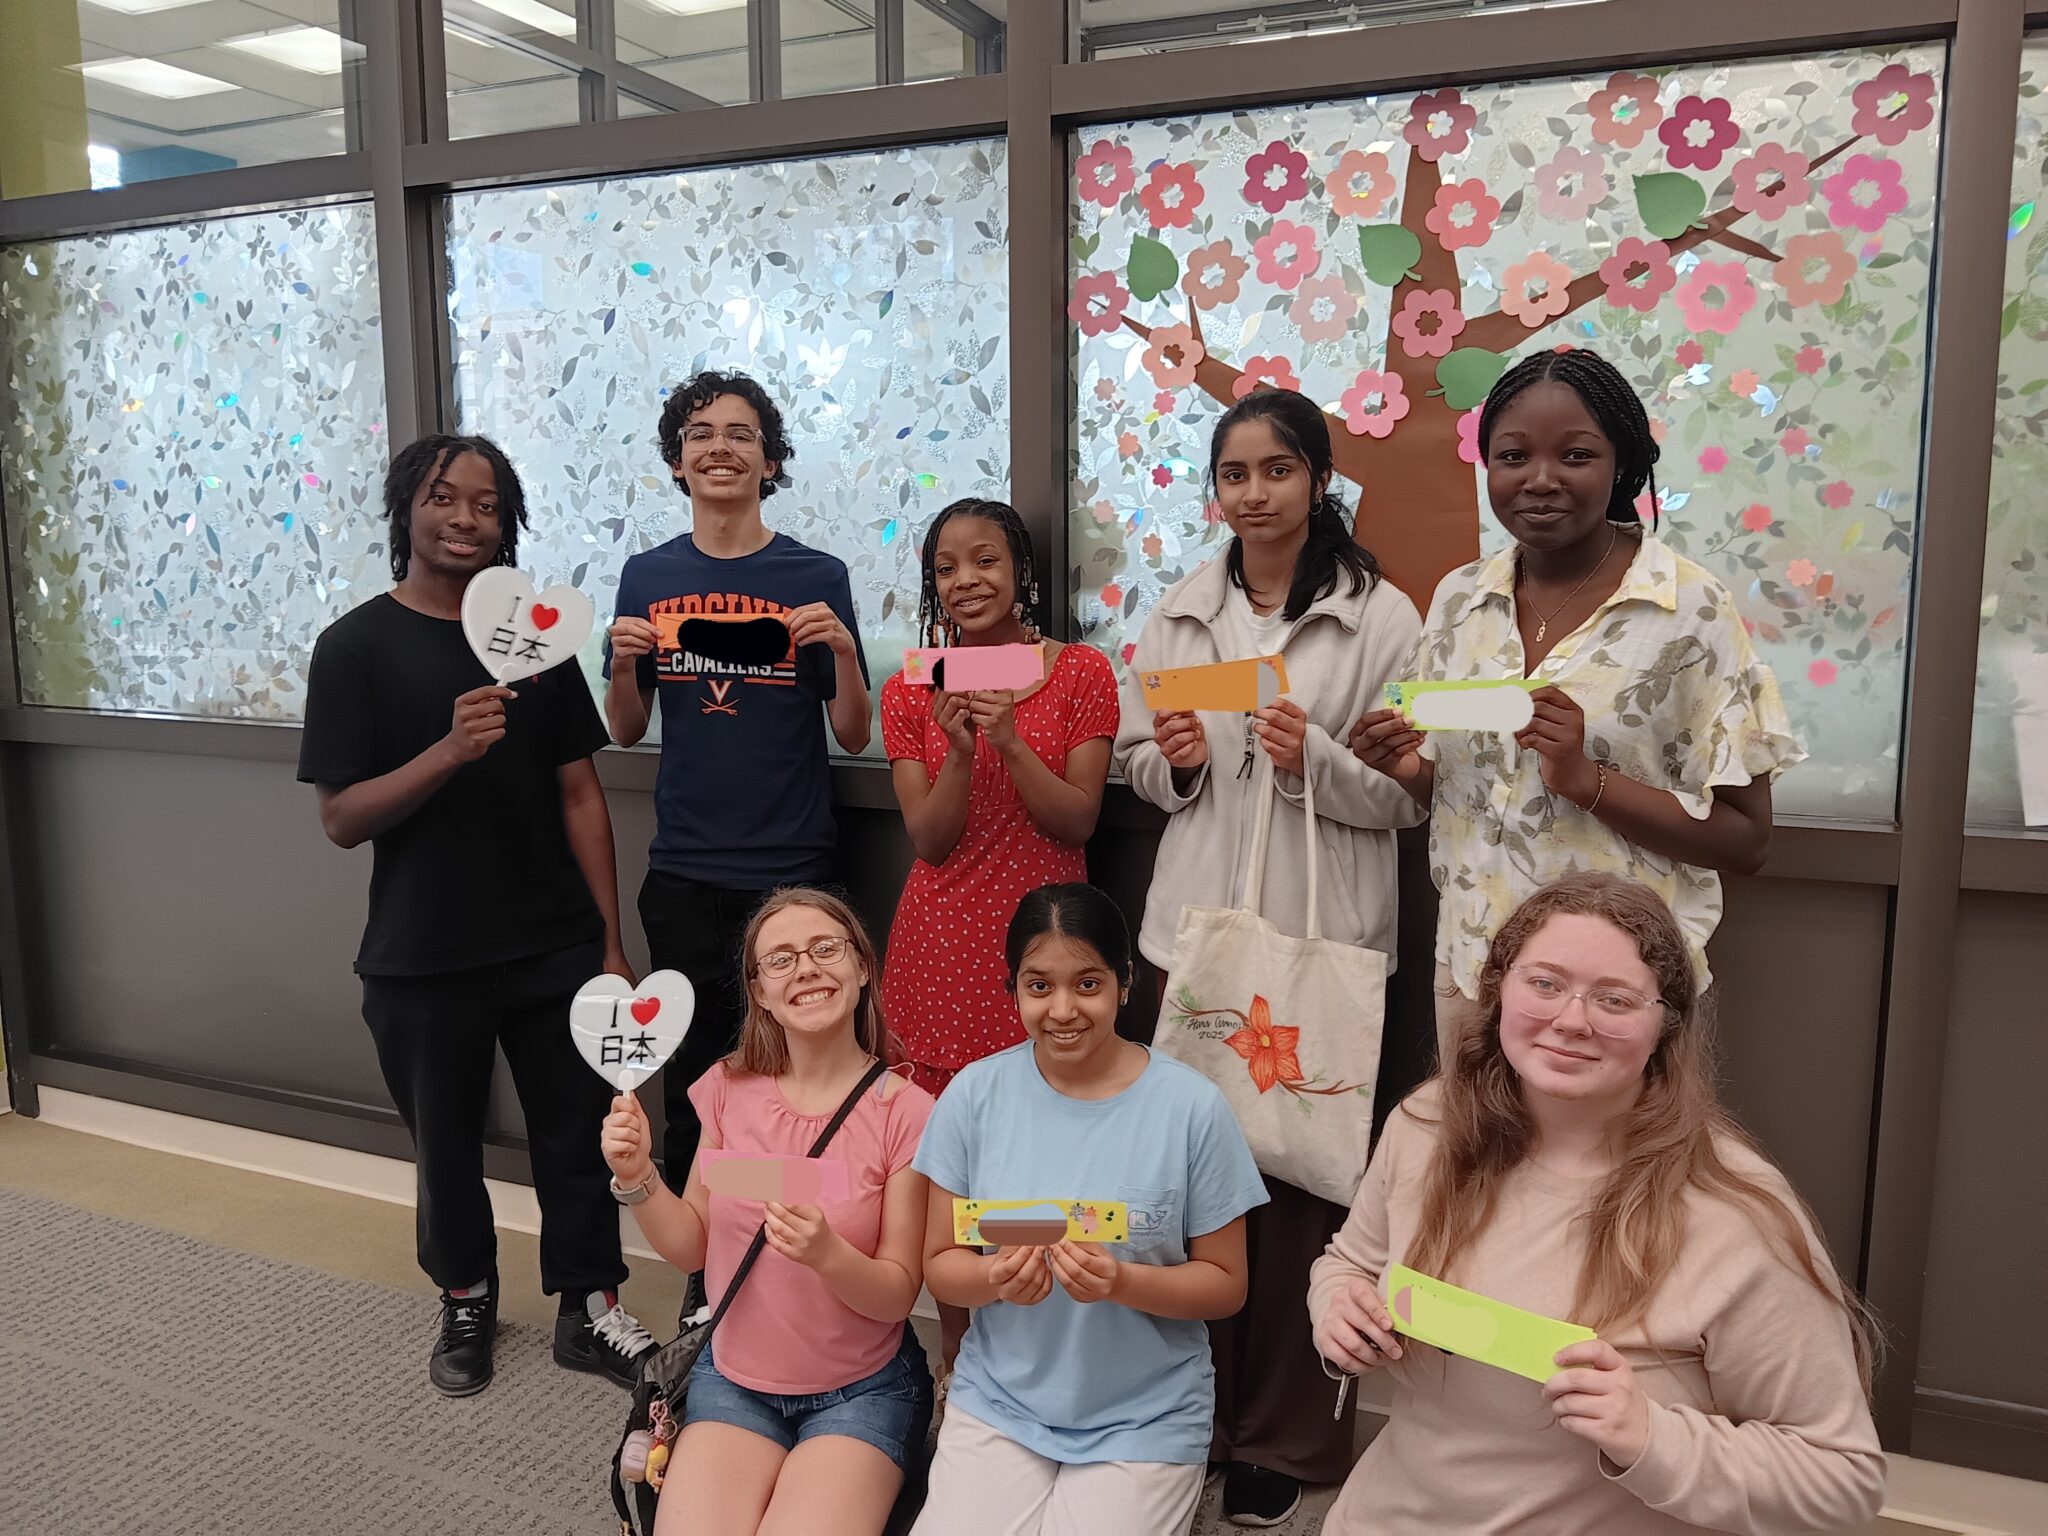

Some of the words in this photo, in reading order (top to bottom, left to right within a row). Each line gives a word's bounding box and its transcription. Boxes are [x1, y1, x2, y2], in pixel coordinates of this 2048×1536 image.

[507, 596, 522, 623] I
[487, 627, 551, 664] 日本
[611, 999, 620, 1028] I
[601, 1031, 657, 1065] 日本
[1198, 1031, 1226, 1040] 2025
